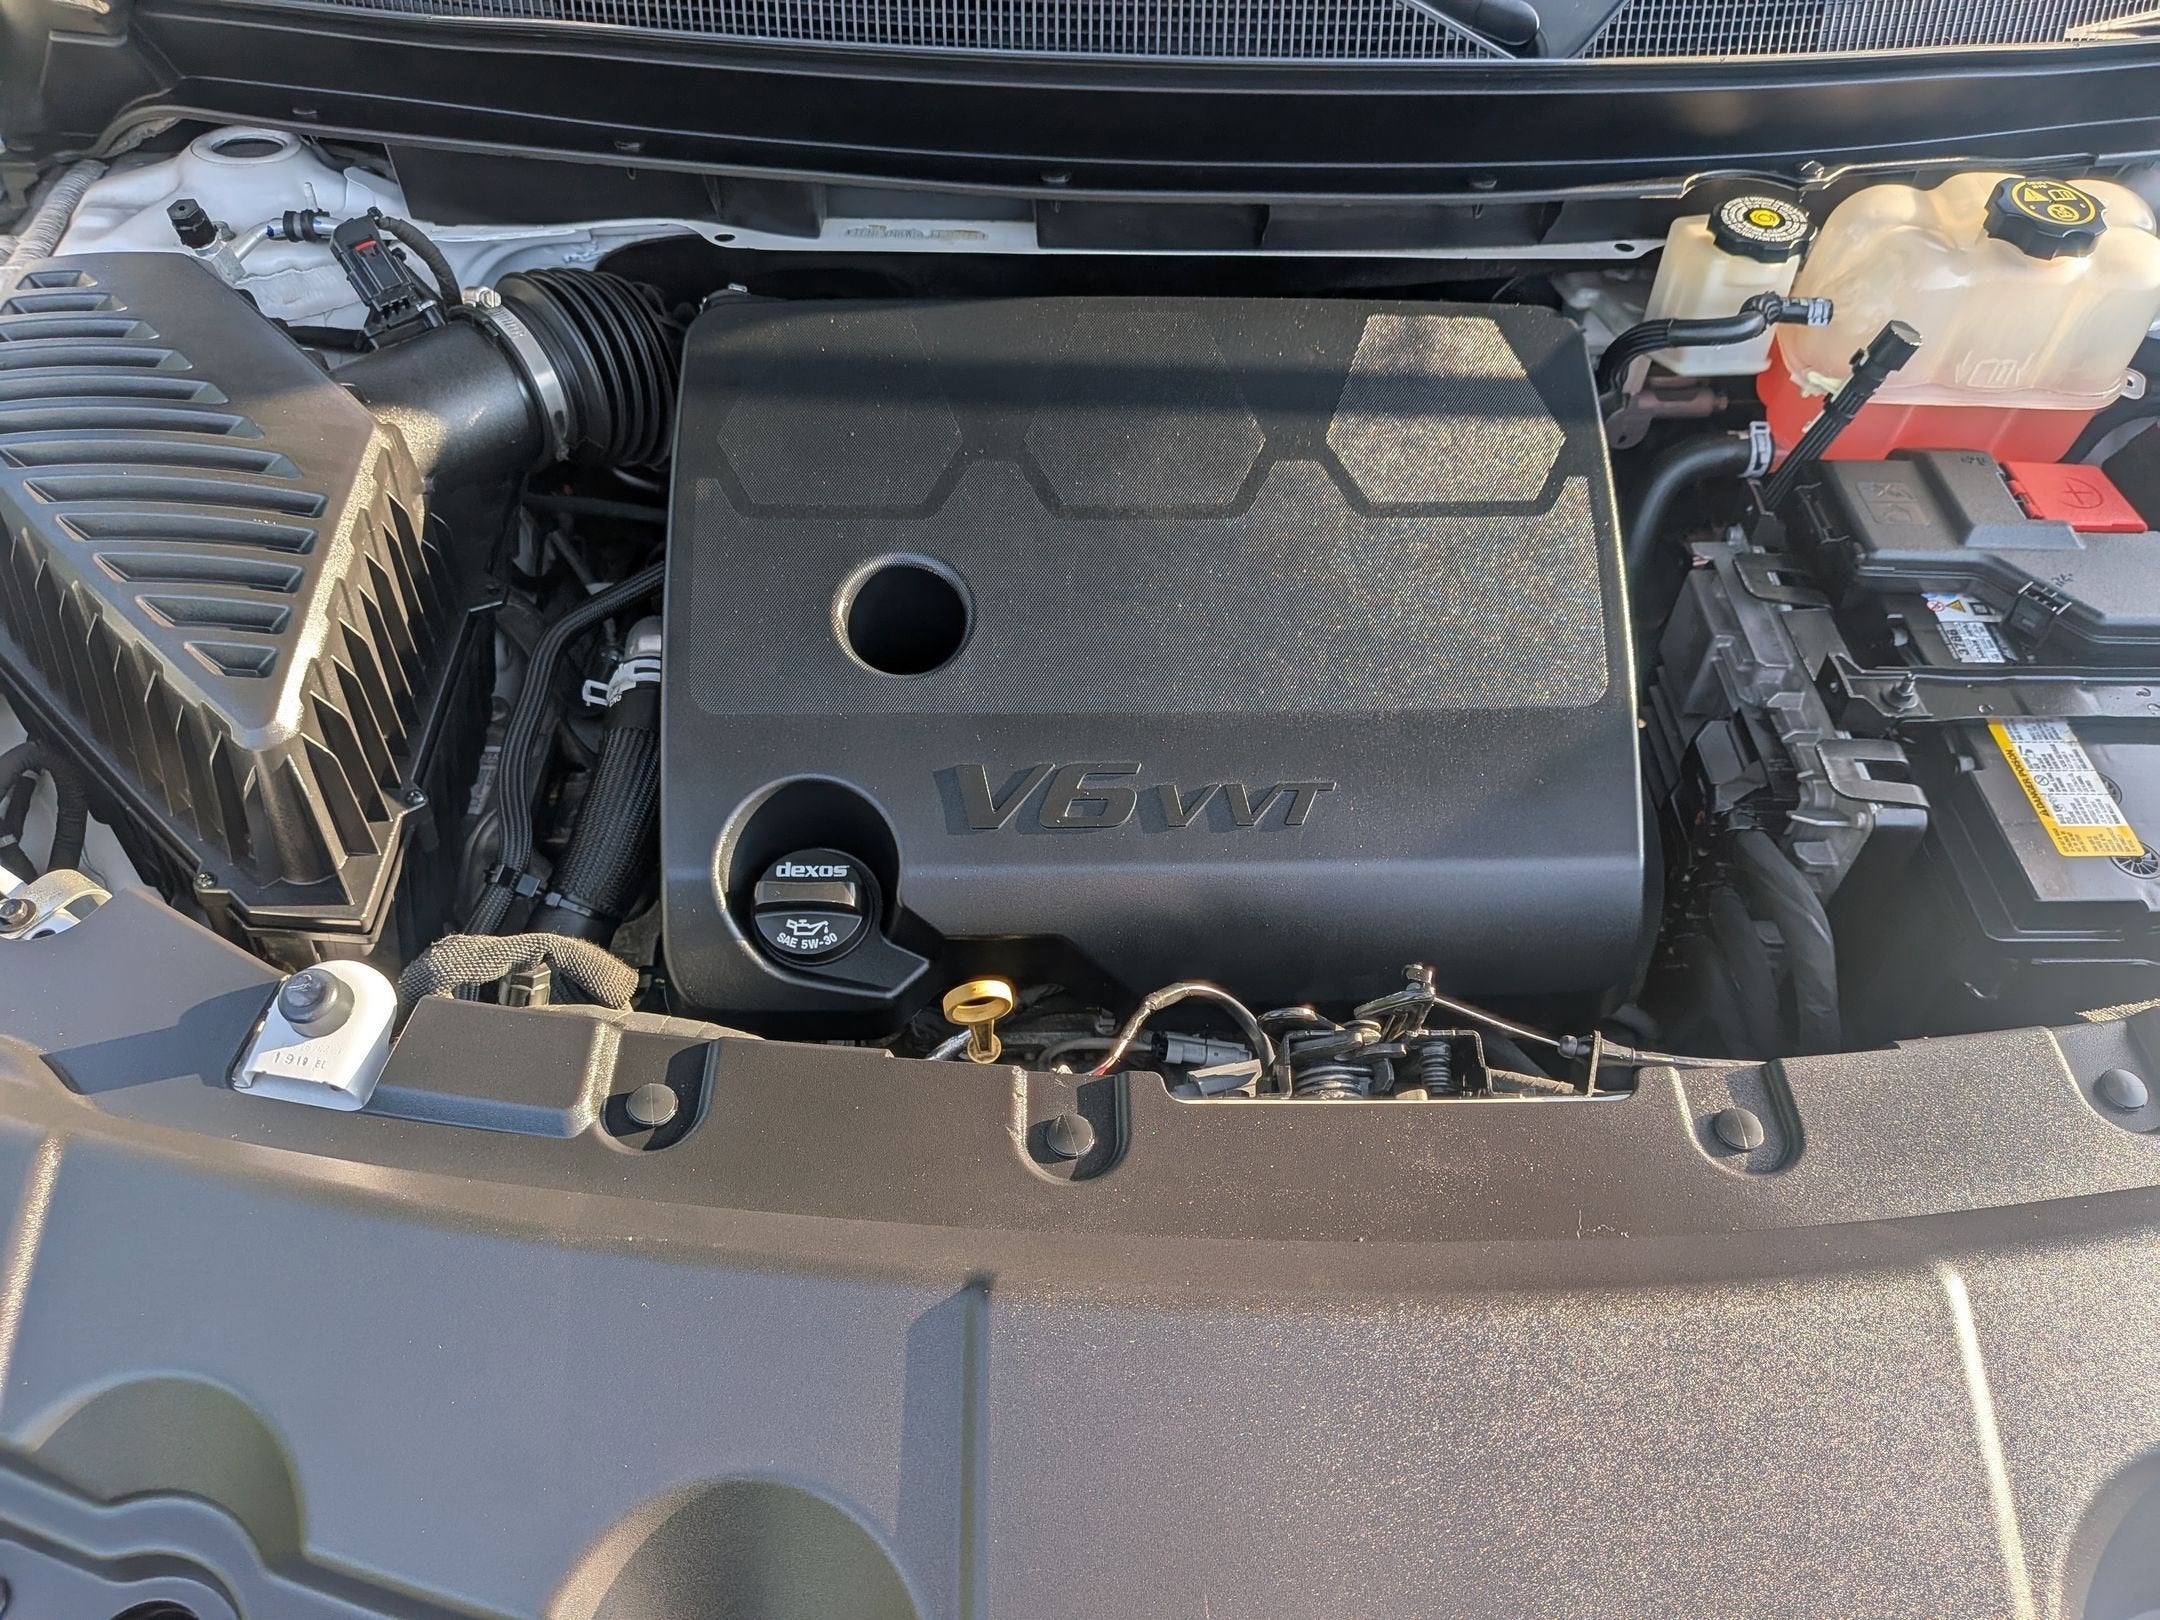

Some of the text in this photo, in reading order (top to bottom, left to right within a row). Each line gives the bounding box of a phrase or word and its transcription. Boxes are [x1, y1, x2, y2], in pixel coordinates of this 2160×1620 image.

[955, 761, 1337, 830] V6 VVT
[2005, 749, 2047, 812] DANGER POISON
[776, 862, 849, 877] dexos
[777, 932, 838, 949] SAE 5W-30
